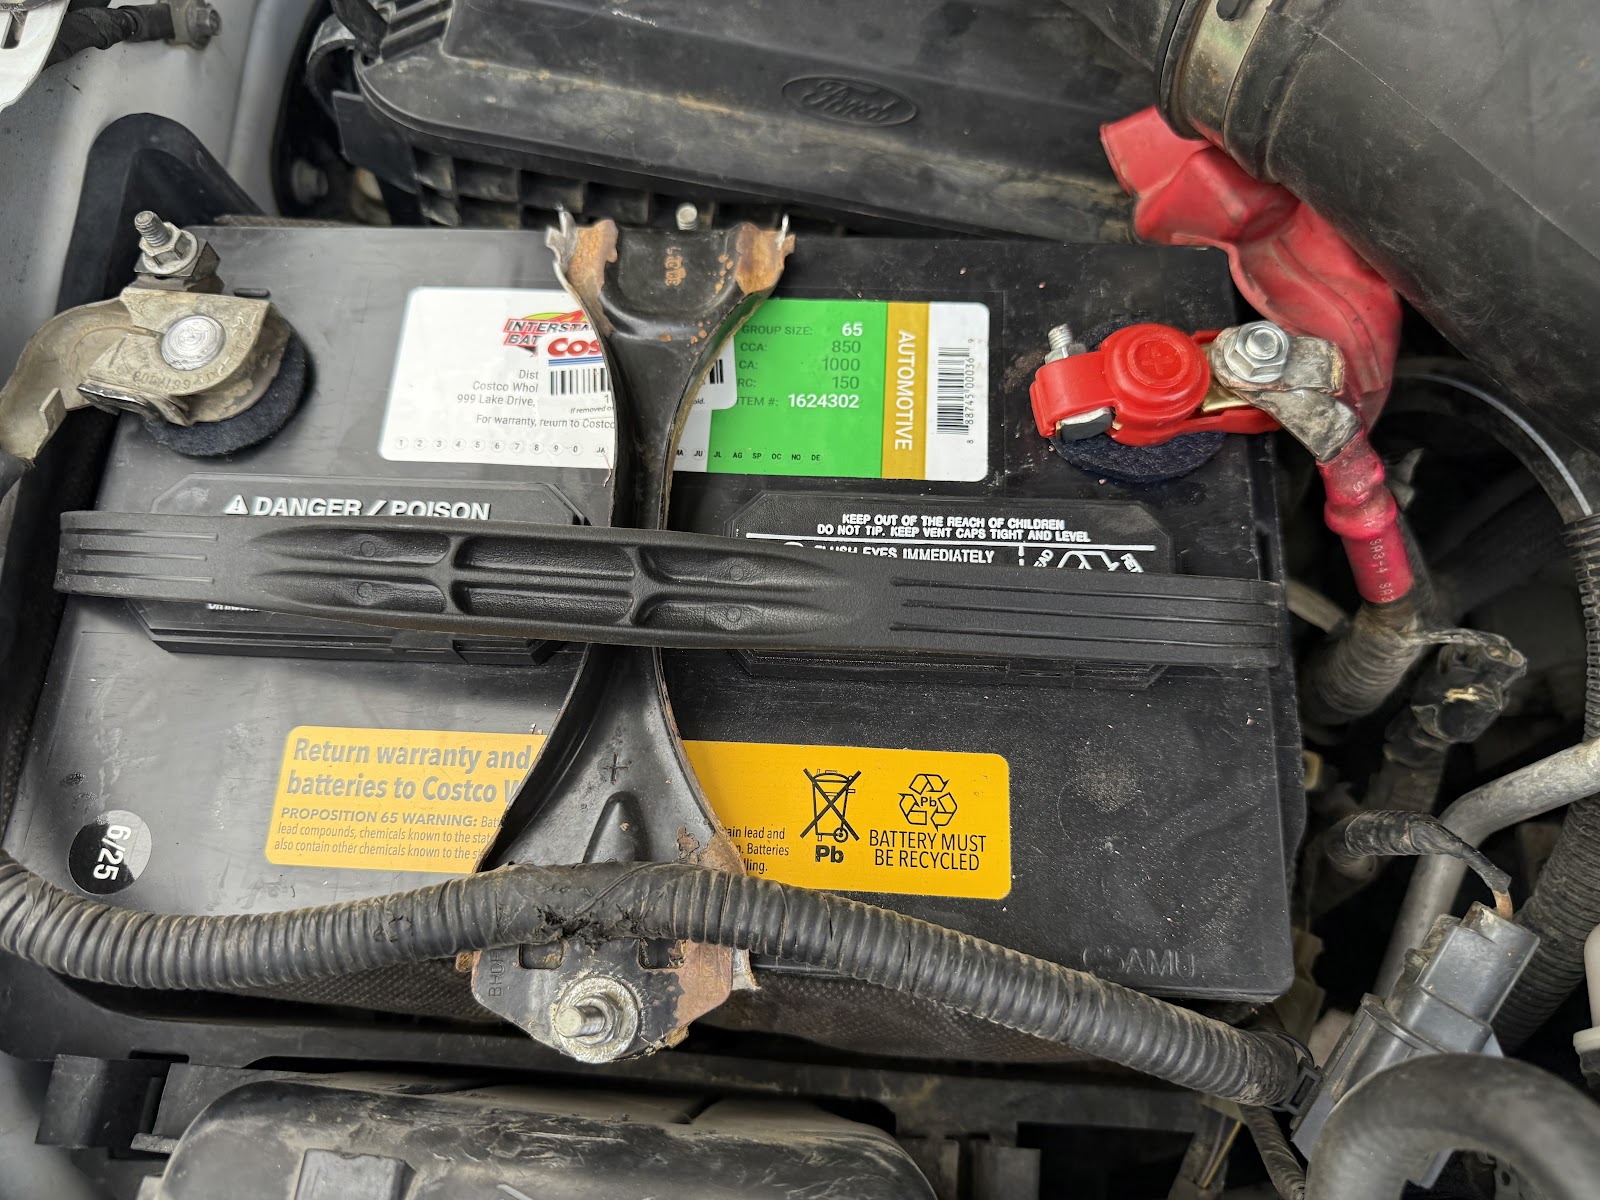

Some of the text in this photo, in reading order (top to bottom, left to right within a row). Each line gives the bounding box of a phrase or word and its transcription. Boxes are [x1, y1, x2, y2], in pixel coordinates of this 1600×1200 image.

[801, 80, 899, 122] Ford
[741, 322, 863, 337] GROUP SIZE: 65
[740, 340, 861, 354] CCA: 850
[738, 357, 861, 372] CA: 1000
[472, 380, 509, 392] Costco
[737, 376, 860, 390] RC: 150
[894, 329, 916, 451] AUTOMOTIVE
[457, 393, 536, 407] 999 Lake Drive,
[787, 393, 860, 408] 1624302
[576, 405, 606, 413] removed
[476, 414, 492, 424] For
[494, 416, 537, 427] warranty,
[571, 419, 579, 428] to
[752, 452, 762, 460] SP
[771, 453, 782, 461] OC
[791, 454, 801, 462] NO
[811, 454, 821, 462] DE
[252, 496, 362, 516] DANGER
[390, 500, 492, 520] POISON
[842, 513, 1065, 530] KEEP OUT OF THE REACH OF CHILDREN
[817, 523, 1092, 542] DO NOT TIP. KEEP VENT CAPS TIGHT AND LEVEL
[902, 548, 995, 563] IMMEDIATELY
[293, 737, 532, 774] Return warranty and
[286, 769, 388, 799] batteries
[393, 776, 417, 800] to
[422, 776, 498, 803] Costco
[920, 795, 937, 808] Pb
[281, 807, 378, 823] PROPOSITION
[380, 811, 399, 824] 65
[402, 812, 478, 828] WARNING:
[277, 822, 298, 836] lead
[300, 825, 357, 840] compounds,
[359, 826, 406, 842] chemicals
[407, 828, 440, 842] known
[442, 830, 453, 843] to
[454, 830, 471, 844] the
[744, 825, 765, 839] lead
[767, 827, 786, 840] and
[274, 838, 294, 851] also
[295, 840, 330, 853] contain
[332, 841, 358, 854] other
[359, 842, 406, 857] chemicals
[407, 844, 440, 858] known
[441, 846, 452, 859] to
[454, 846, 471, 860] the
[747, 842, 790, 856] Batteries
[869, 829, 987, 853] BATTERY MUST
[92, 824, 132, 881] 6/25
[815, 844, 844, 863] Pb
[874, 849, 980, 872] BE RECYCLED
